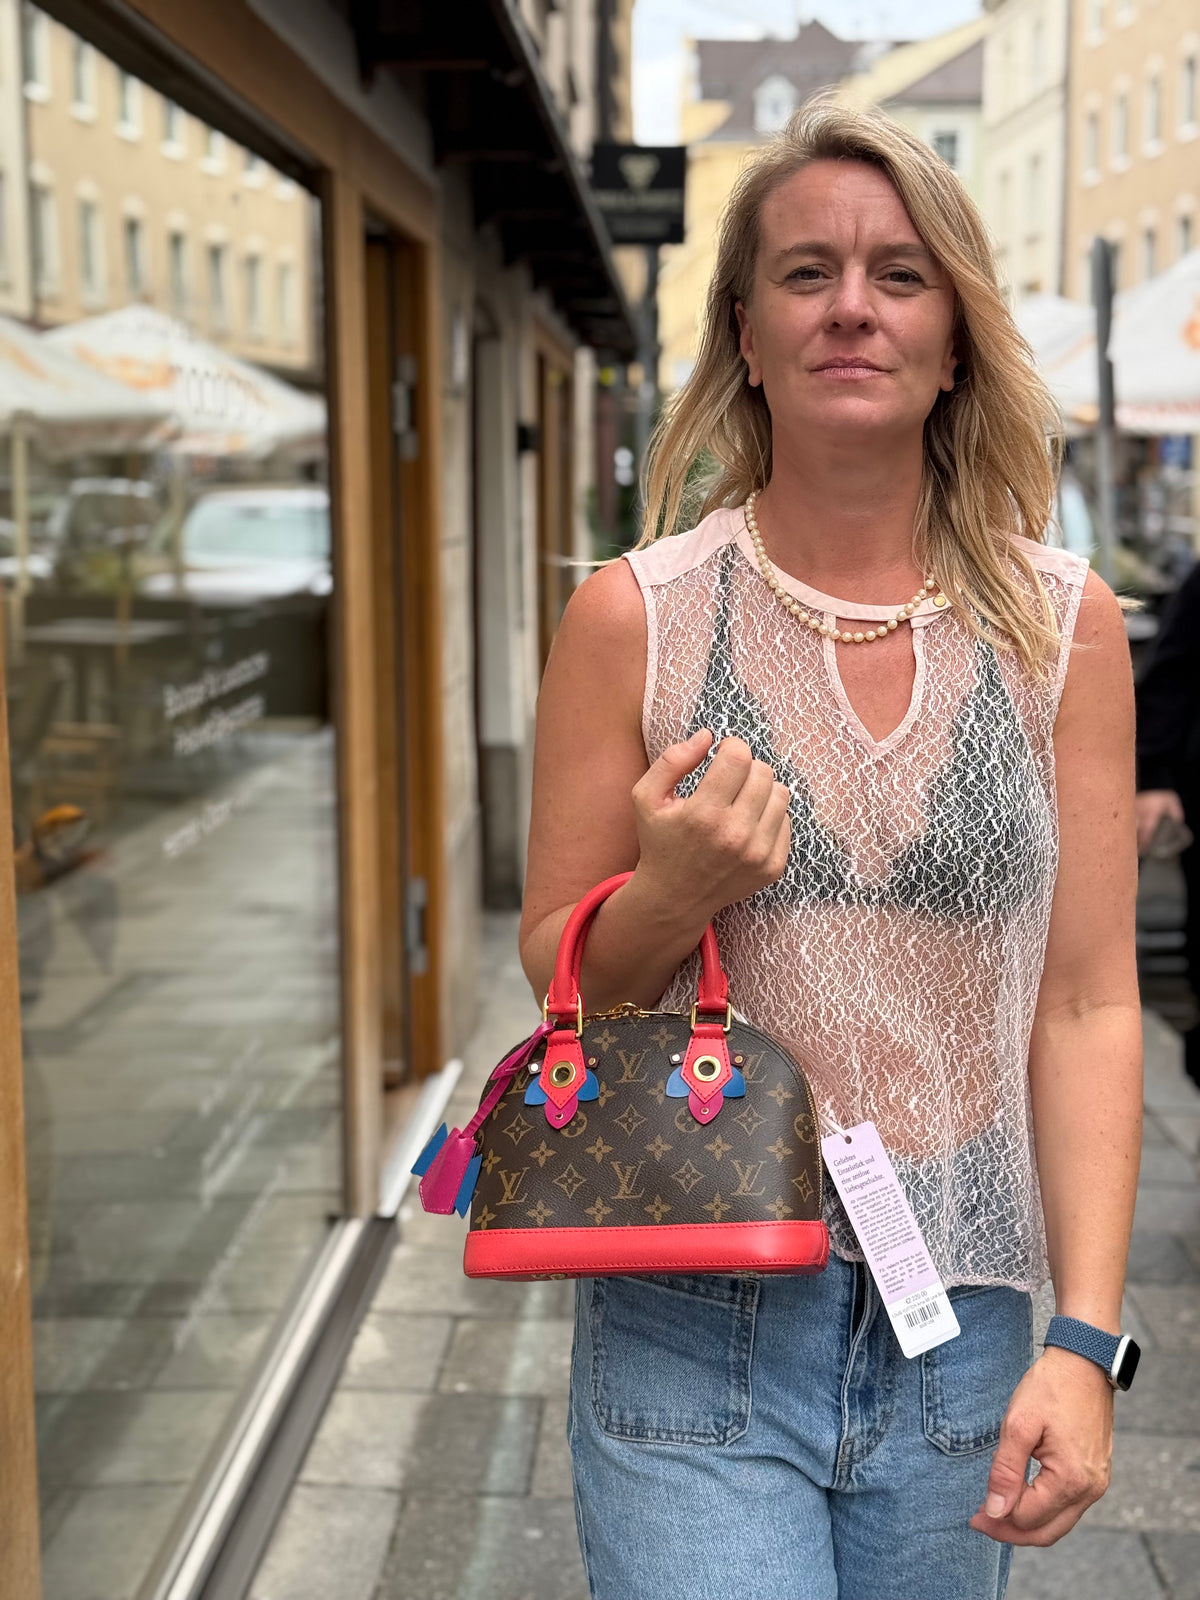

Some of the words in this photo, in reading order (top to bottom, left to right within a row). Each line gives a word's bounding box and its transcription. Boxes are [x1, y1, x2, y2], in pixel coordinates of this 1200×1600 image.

[616, 1050, 648, 1083] LV
[495, 1166, 529, 1206] LV
[610, 1160, 647, 1200] LV
[731, 1160, 767, 1197] LV
